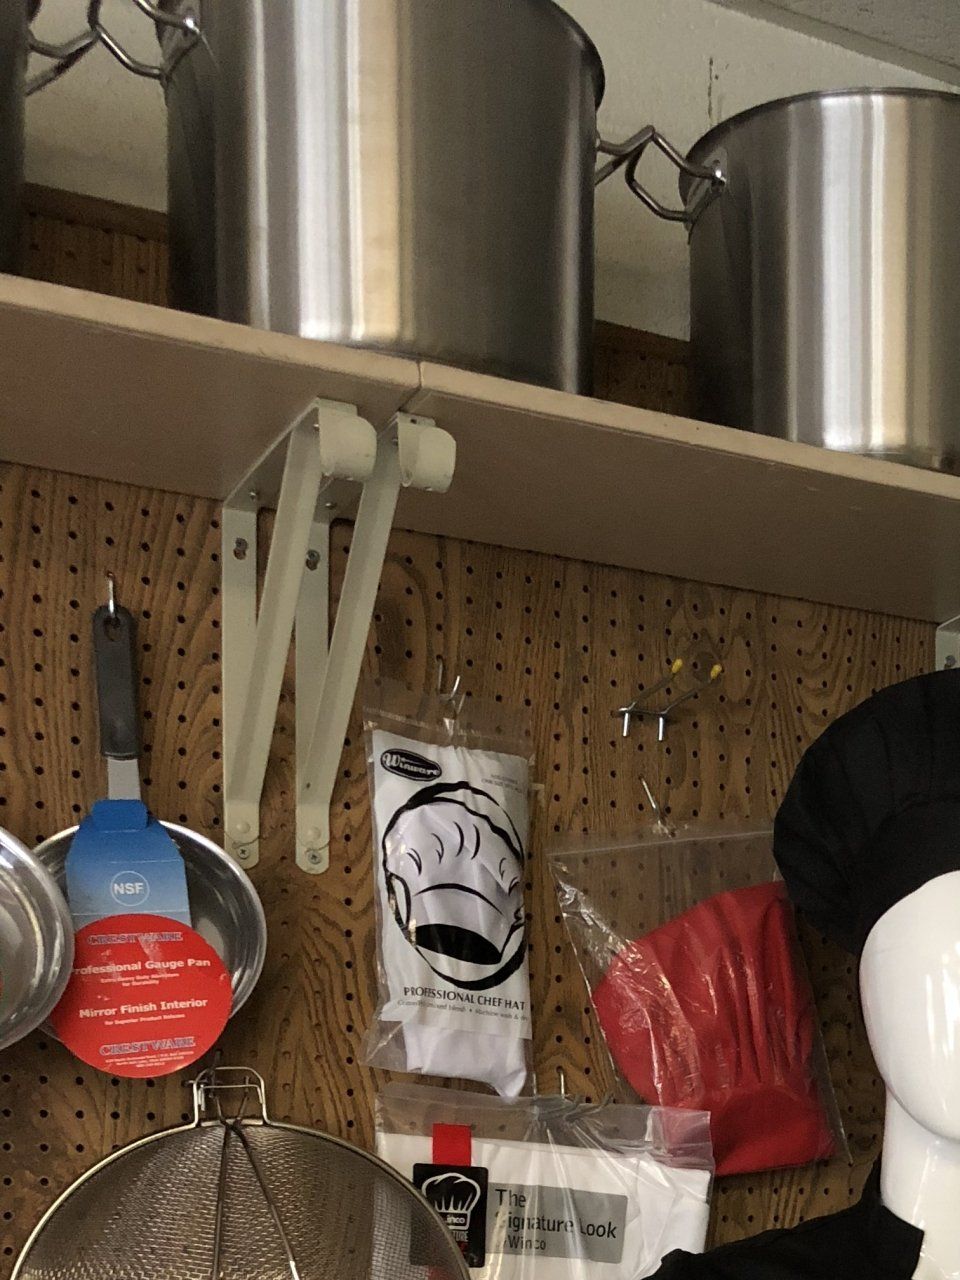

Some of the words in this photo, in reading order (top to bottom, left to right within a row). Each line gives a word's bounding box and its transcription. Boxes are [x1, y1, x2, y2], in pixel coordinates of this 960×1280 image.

[113, 882, 144, 895] NSF
[72, 961, 142, 976] rofessional
[145, 959, 185, 971] Gauge
[187, 958, 211, 968] Pan
[79, 1007, 118, 1019] Mirror
[120, 1002, 157, 1015] Finish
[160, 998, 209, 1011] Interior
[477, 995, 503, 1007] CHEF
[504, 1000, 526, 1011] HAT
[495, 1188, 526, 1208] The
